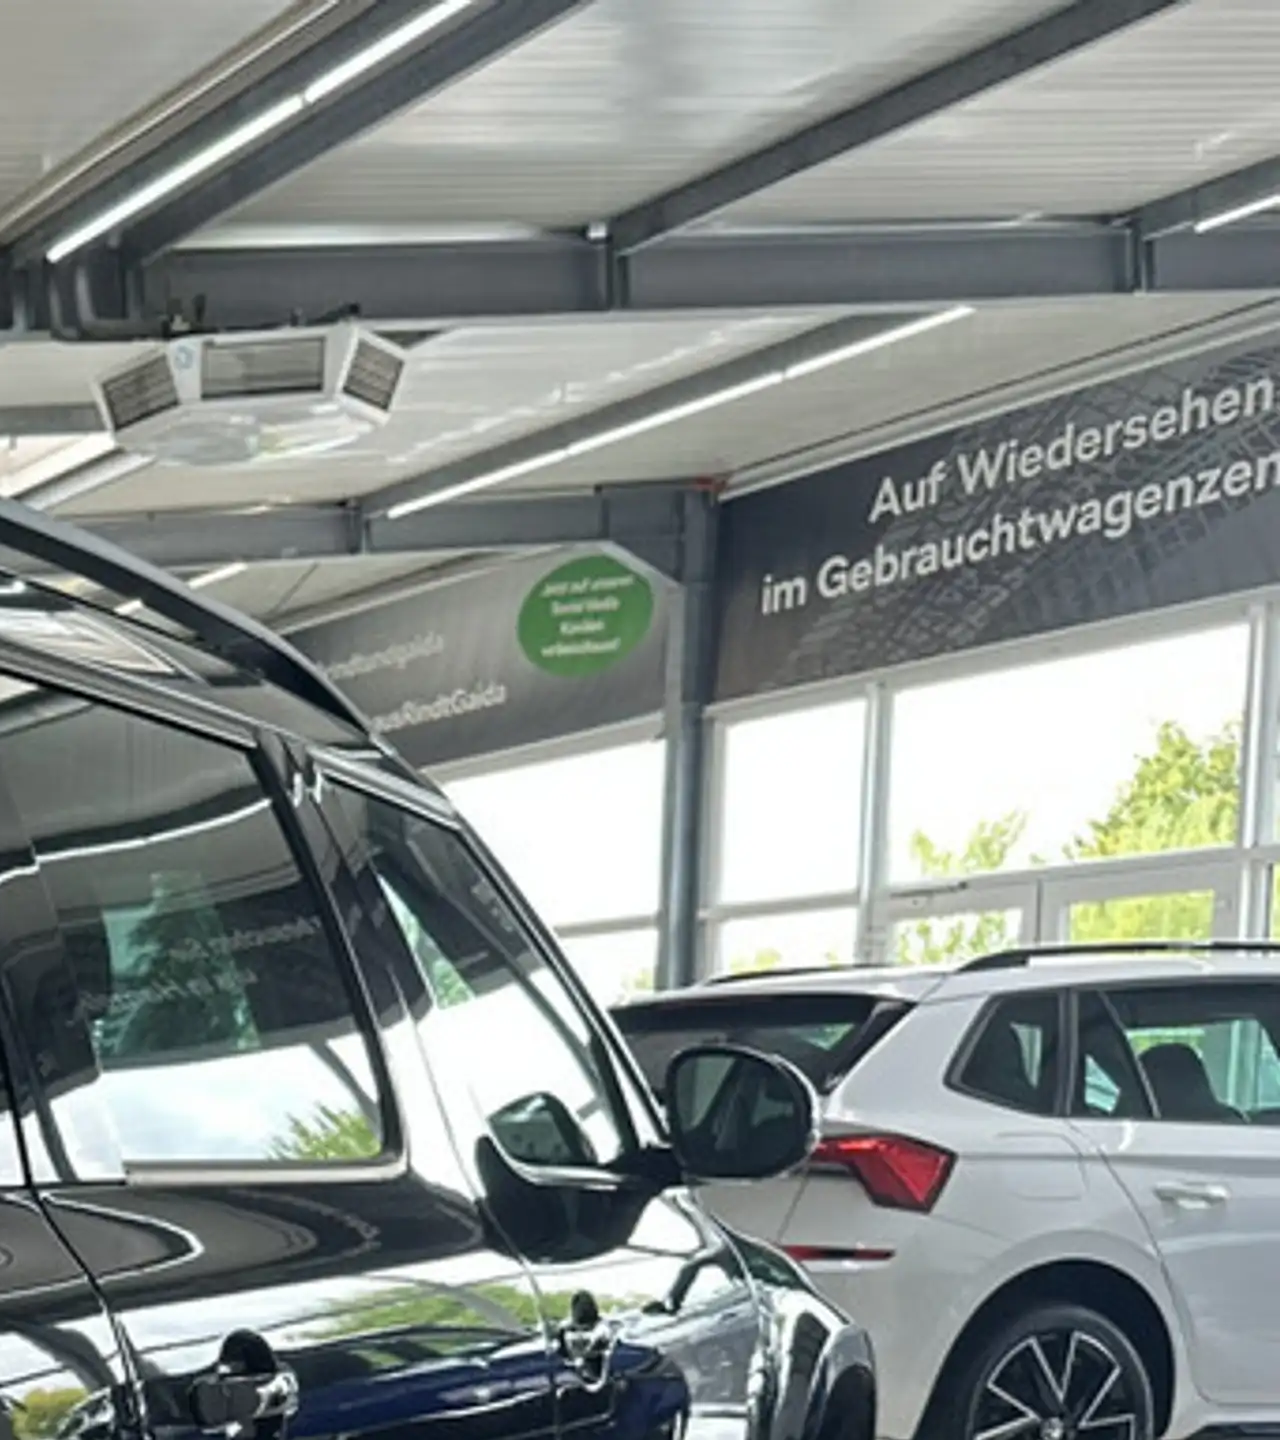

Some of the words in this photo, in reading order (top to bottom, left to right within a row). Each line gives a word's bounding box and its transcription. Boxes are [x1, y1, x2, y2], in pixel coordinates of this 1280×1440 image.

[868, 460, 947, 523] Auf
[956, 377, 1274, 495] Wiedersehen
[761, 572, 807, 615] im
